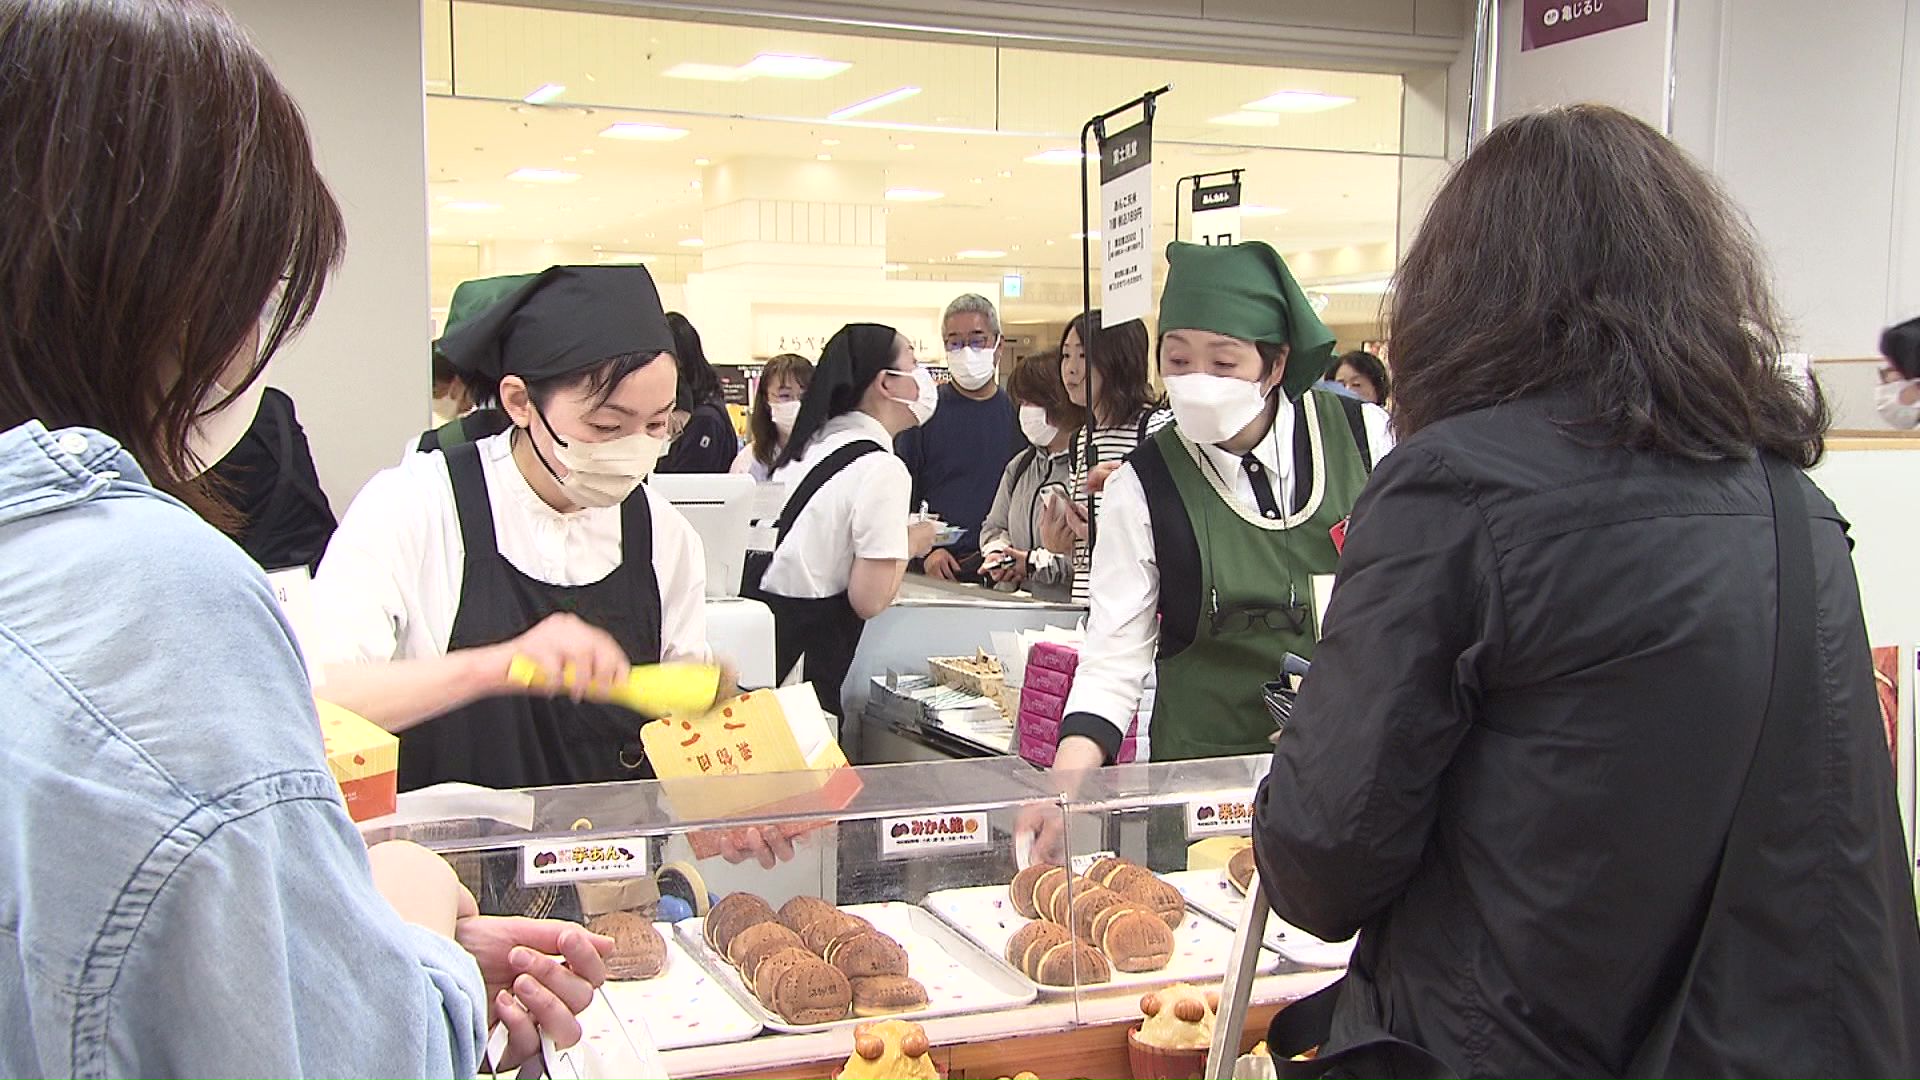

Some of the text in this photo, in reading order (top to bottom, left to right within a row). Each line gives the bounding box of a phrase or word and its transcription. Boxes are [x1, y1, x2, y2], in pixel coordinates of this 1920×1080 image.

[911, 816, 965, 836] みかん餡
[572, 845, 621, 864] 芋あん
